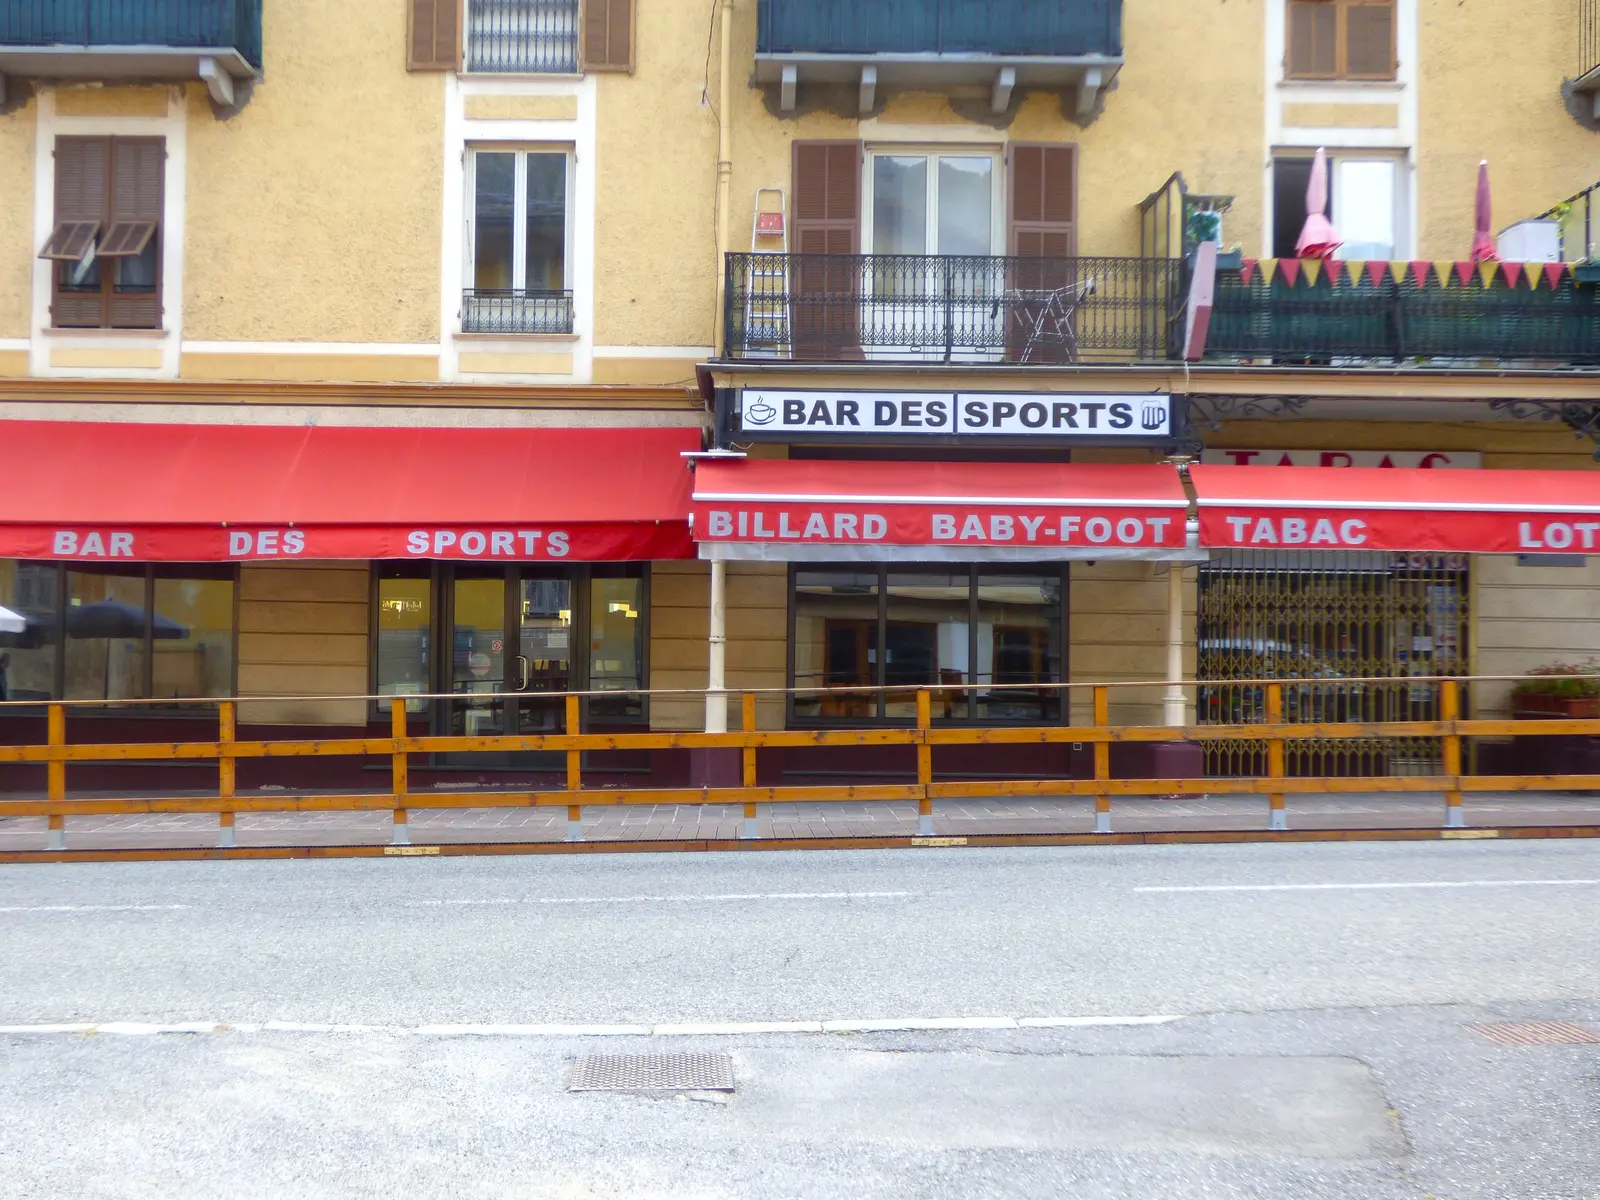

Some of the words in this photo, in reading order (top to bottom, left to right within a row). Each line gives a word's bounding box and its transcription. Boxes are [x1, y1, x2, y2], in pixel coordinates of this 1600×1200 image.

[783, 399, 860, 426] BAR
[874, 400, 948, 427] DES
[963, 401, 1134, 429] SPORTS
[708, 509, 888, 541] BILLARD
[931, 513, 1171, 545] BABY-FOOT
[1226, 516, 1367, 546] TABAC
[1519, 521, 1600, 548] LOT
[53, 530, 134, 557] BAR
[229, 530, 305, 556] DES
[406, 530, 570, 558] SPORTS
